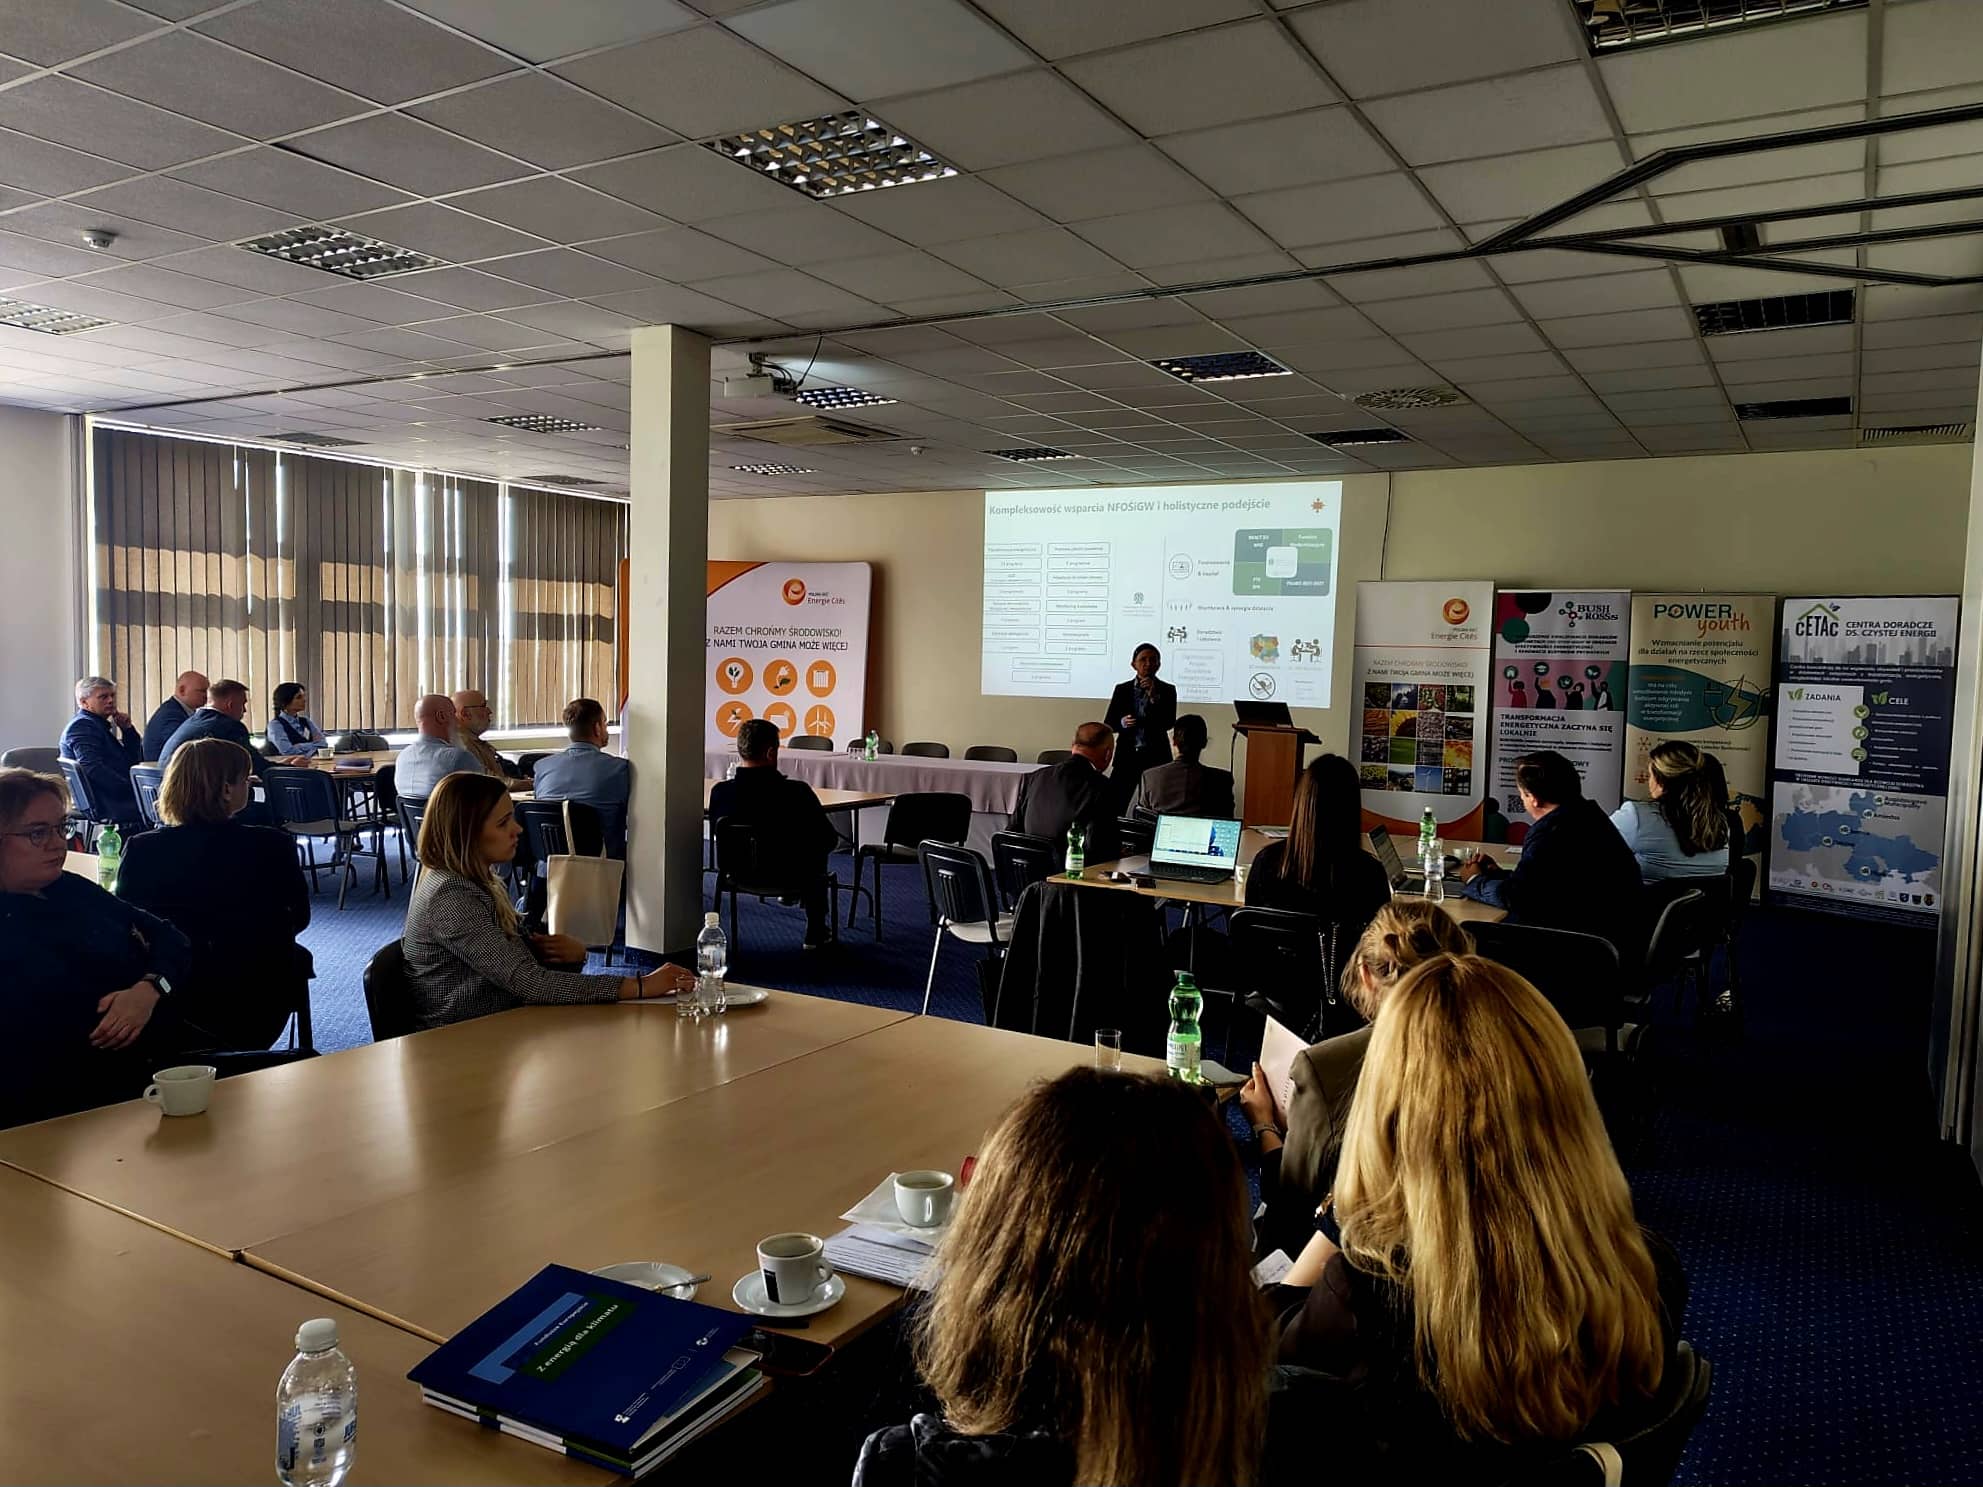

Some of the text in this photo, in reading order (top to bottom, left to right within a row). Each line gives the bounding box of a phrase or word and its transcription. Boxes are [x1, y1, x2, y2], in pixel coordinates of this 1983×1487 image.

[989, 504, 1061, 517] Kompleksowość
[1064, 504, 1104, 516] wsparcia
[1107, 501, 1154, 512] NFOSiGW
[1163, 500, 1218, 513] holistyczne
[1221, 499, 1271, 512] podejście
[808, 597, 830, 606] Energie
[1577, 604, 1609, 613] BUSH
[1654, 604, 1732, 619] POWER
[1697, 612, 1750, 639] youth
[1846, 621, 1933, 629] CENTRA DORADCZE
[713, 625, 842, 638] RAZEM CHROŃMY ŚRODOWISKO!
[1845, 629, 1858, 637] DS.
[1431, 632, 1458, 641] Energie
[713, 639, 736, 648] NAMI
[739, 639, 768, 649] TWOJA
[770, 640, 797, 649] GMINA
[799, 640, 820, 650] MOŻE
[822, 641, 848, 652] WIĘCEJ
[1651, 639, 1743, 648] Wzmacnianie potencjału
[1638, 647, 1649, 655] dla
[1651, 647, 1677, 655] działań
[1710, 648, 1759, 657] społeczności
[1668, 658, 1727, 666] energetycznych
[1805, 693, 1841, 702] ZADANIA
[1888, 697, 1910, 705] CELE
[1501, 714, 1566, 722] TRANSFORMACJA
[1500, 722, 1559, 730] ENERGETYCZNA
[1599, 725, 1613, 733] SIĘ
[1500, 729, 1537, 737] LOKALNIE
[536, 1303, 619, 1373] Z energią dla klimatu
